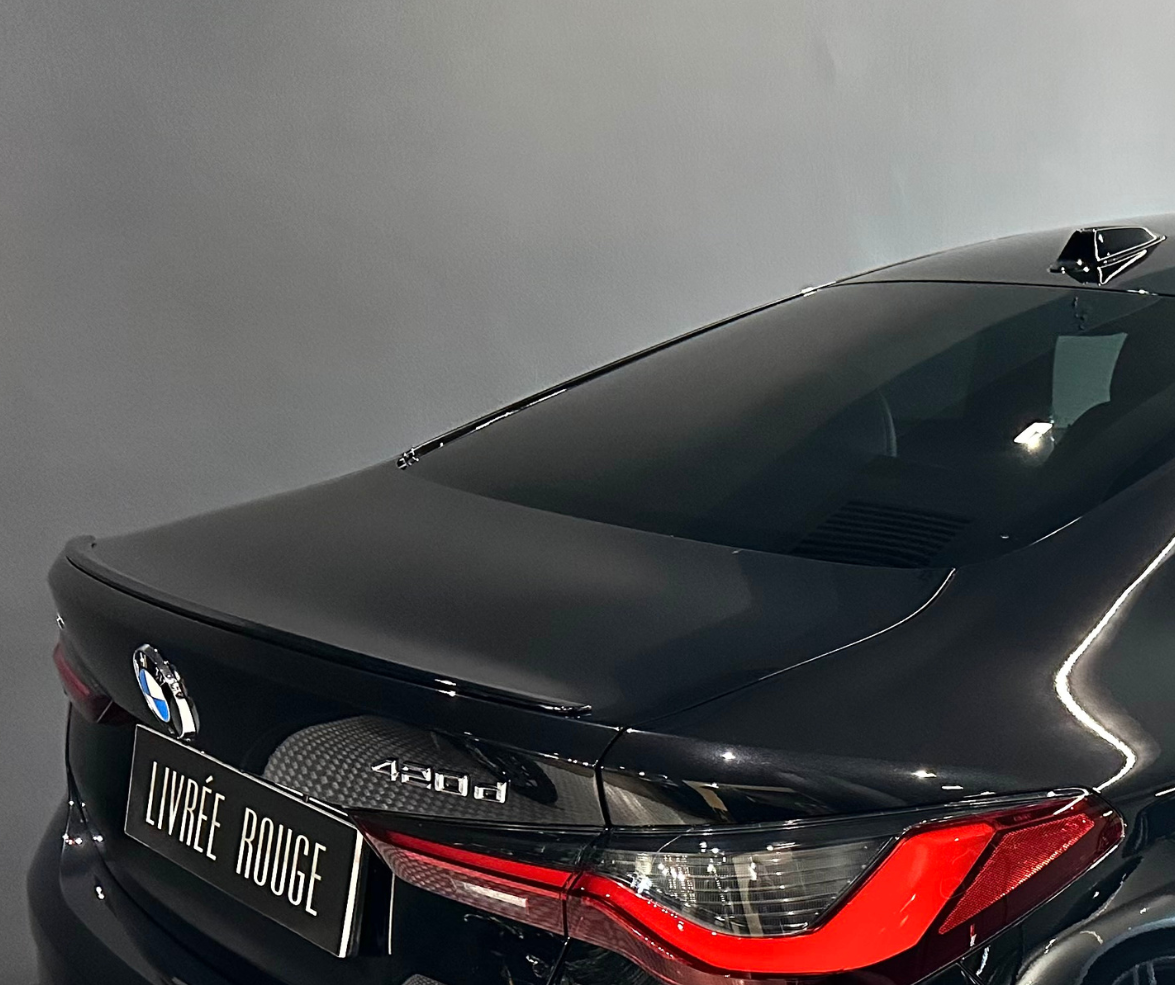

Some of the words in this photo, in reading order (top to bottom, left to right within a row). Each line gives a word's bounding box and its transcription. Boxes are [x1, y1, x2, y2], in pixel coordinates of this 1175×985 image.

[371, 759, 508, 804] 420d
[145, 760, 226, 861] LIVRÉE
[235, 807, 327, 917] ROUGE
